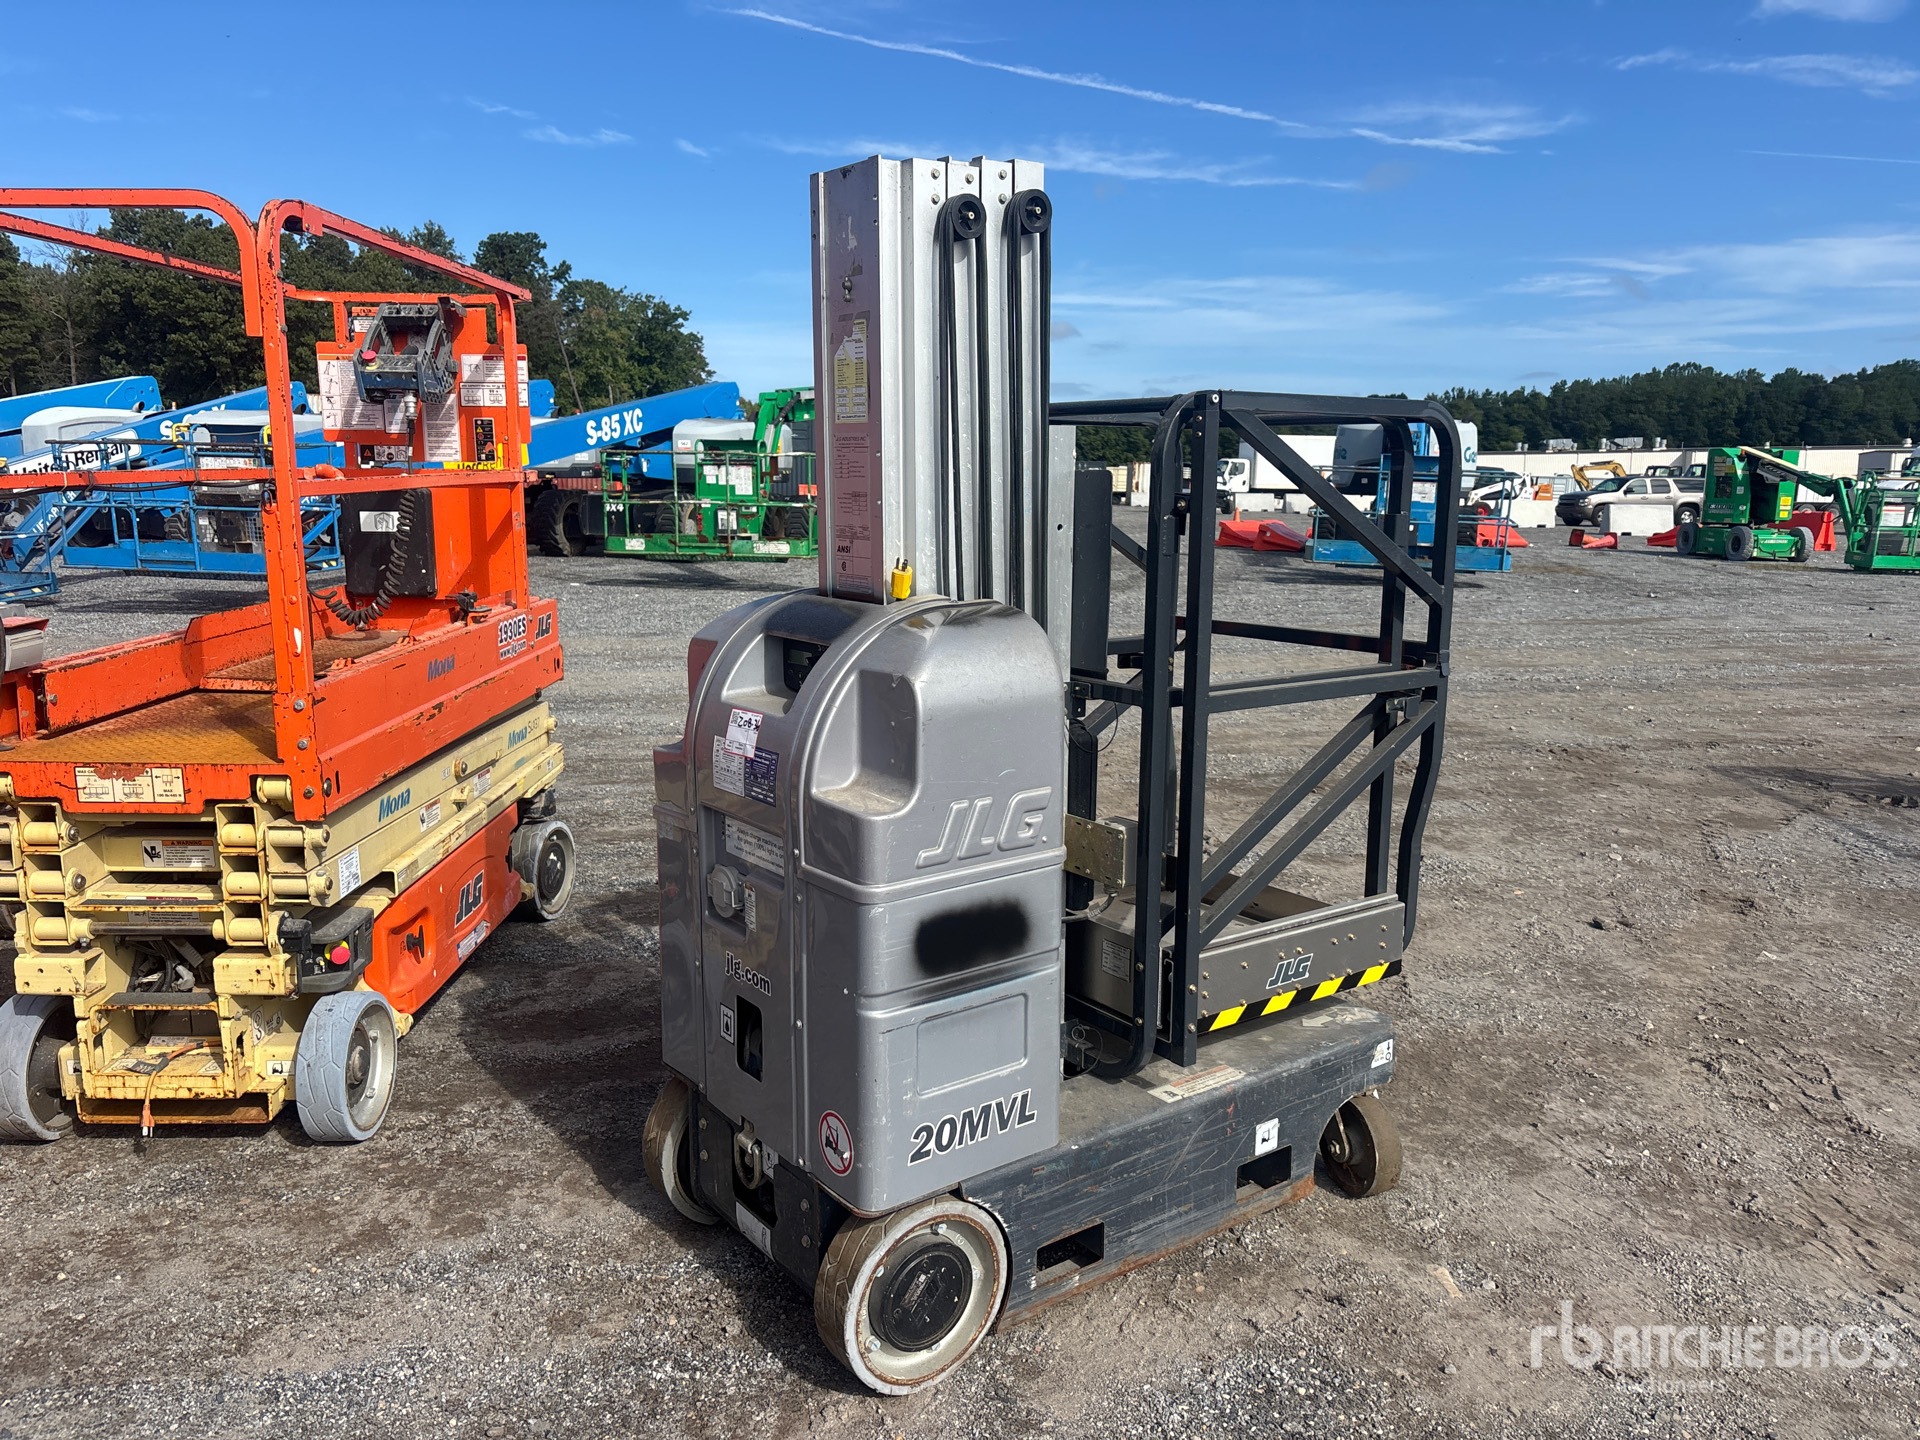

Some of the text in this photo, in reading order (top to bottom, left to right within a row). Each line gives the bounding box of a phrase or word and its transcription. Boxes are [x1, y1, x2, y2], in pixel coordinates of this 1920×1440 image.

[586, 408, 643, 446] S-85 XC
[837, 545, 851, 553] ANSI
[498, 612, 552, 646] 1930ES JLG
[500, 639, 527, 660] www.jlg.com
[427, 654, 456, 682] Mona
[507, 726, 528, 750] Mona
[378, 788, 411, 822] Mona
[915, 786, 1053, 869] JLG
[454, 869, 485, 929] JLG
[725, 950, 772, 996] jlg.com
[1266, 953, 1314, 989] JLG
[907, 1088, 1038, 1167] 20MVL
